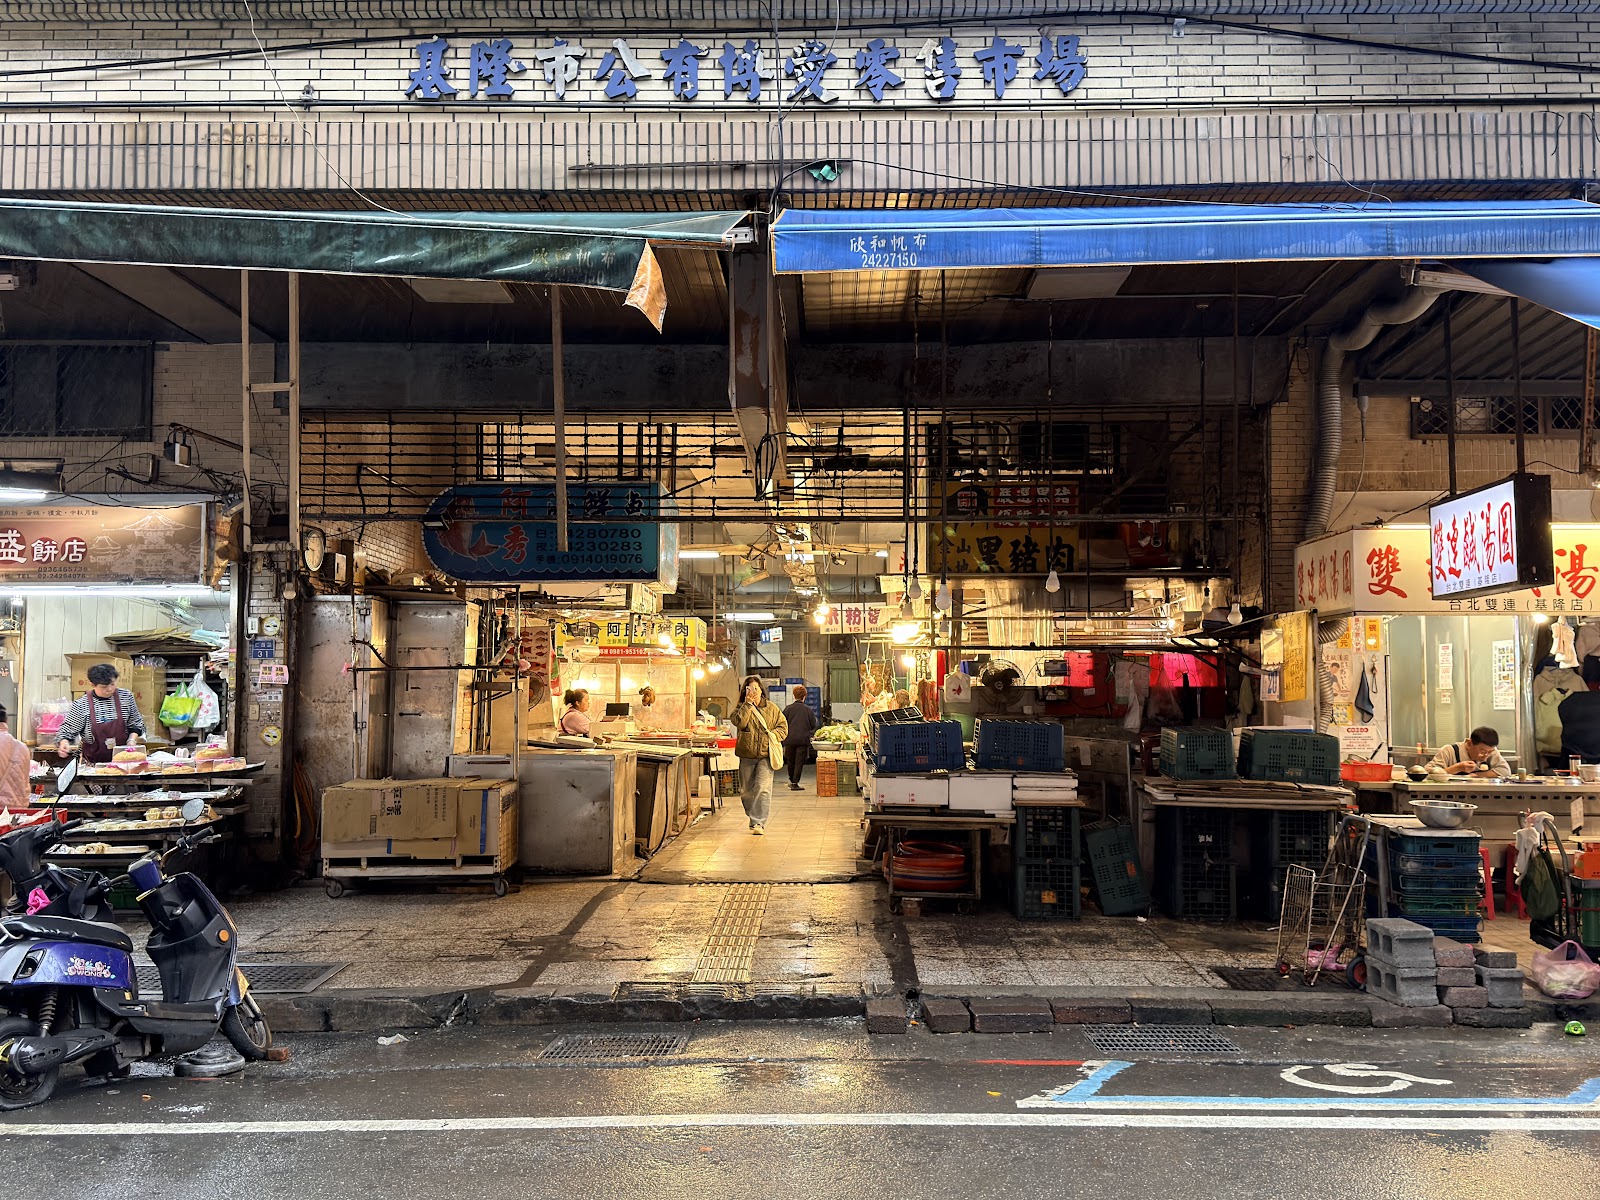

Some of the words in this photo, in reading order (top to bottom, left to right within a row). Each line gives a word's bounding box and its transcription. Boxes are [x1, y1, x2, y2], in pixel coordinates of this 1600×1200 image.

[405, 36, 1088, 103] 基隆市公有博愛零售市場
[850, 233, 927, 253] 欣和帆布
[862, 252, 917, 268] 24227150
[536, 528, 641, 539] 日:4280780
[536, 541, 642, 552] 夜:4230283
[257, 650, 269, 658] 31
